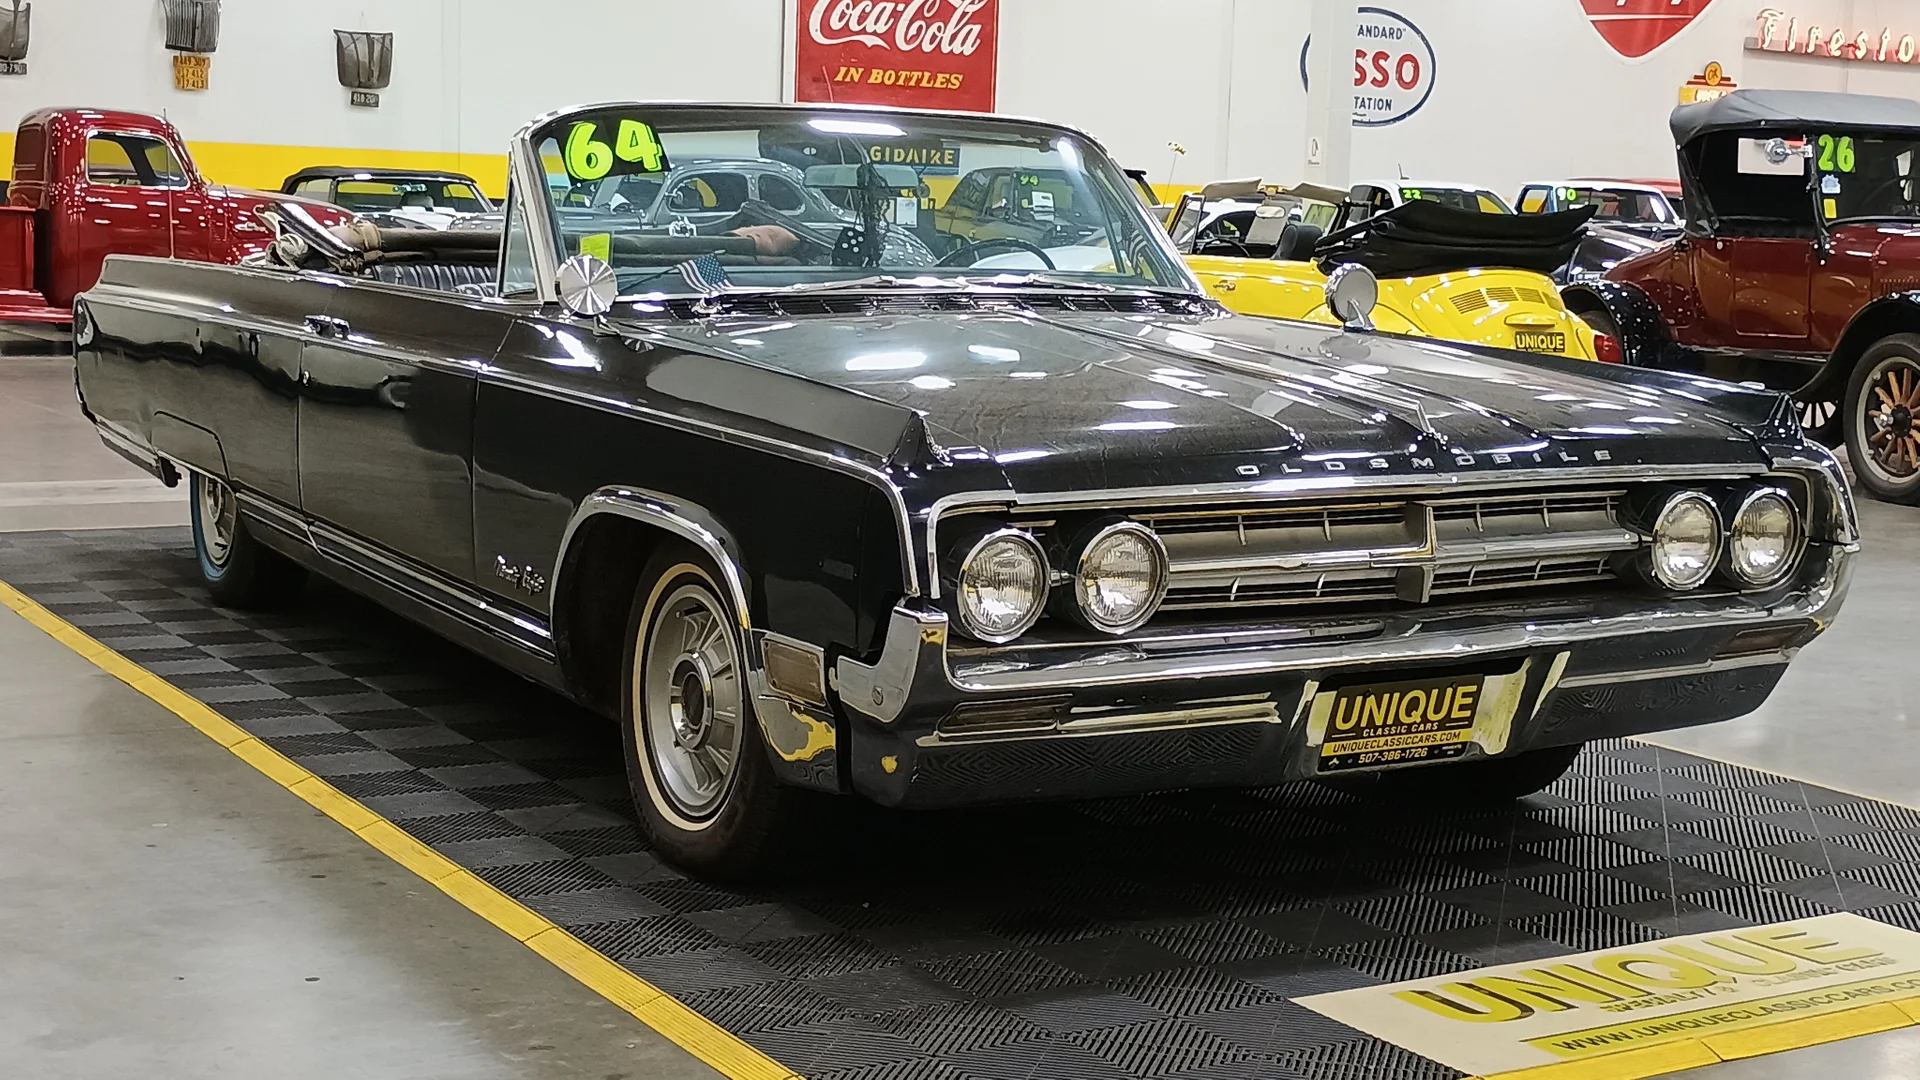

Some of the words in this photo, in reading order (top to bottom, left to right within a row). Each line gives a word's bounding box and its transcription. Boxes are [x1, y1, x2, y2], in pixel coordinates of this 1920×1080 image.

[809, 0, 982, 56] Coca-Cola
[1756, 8, 1916, 63] Firesto
[834, 66, 864, 83] IN
[868, 69, 963, 89] BOTTLES
[1354, 49, 1420, 90] SSO
[1354, 96, 1392, 111] TATION
[565, 119, 663, 180] 64
[1818, 134, 1855, 172] 26
[1516, 333, 1563, 348] UNIQUE
[1236, 450, 1611, 477] OLDSMOBILE
[1335, 685, 1478, 731] UNIQUE
[1332, 731, 1462, 753] UNIQUECLASSICCARS.COM
[1362, 726, 1407, 737] CLASSIC
[1411, 722, 1439, 732] CARS
[1358, 748, 1428, 764] 507-386-1726
[1392, 927, 1885, 1023] UNIQUE
[1551, 979, 1920, 1050] WWW.UNIQUECLASSICCARS.CO
